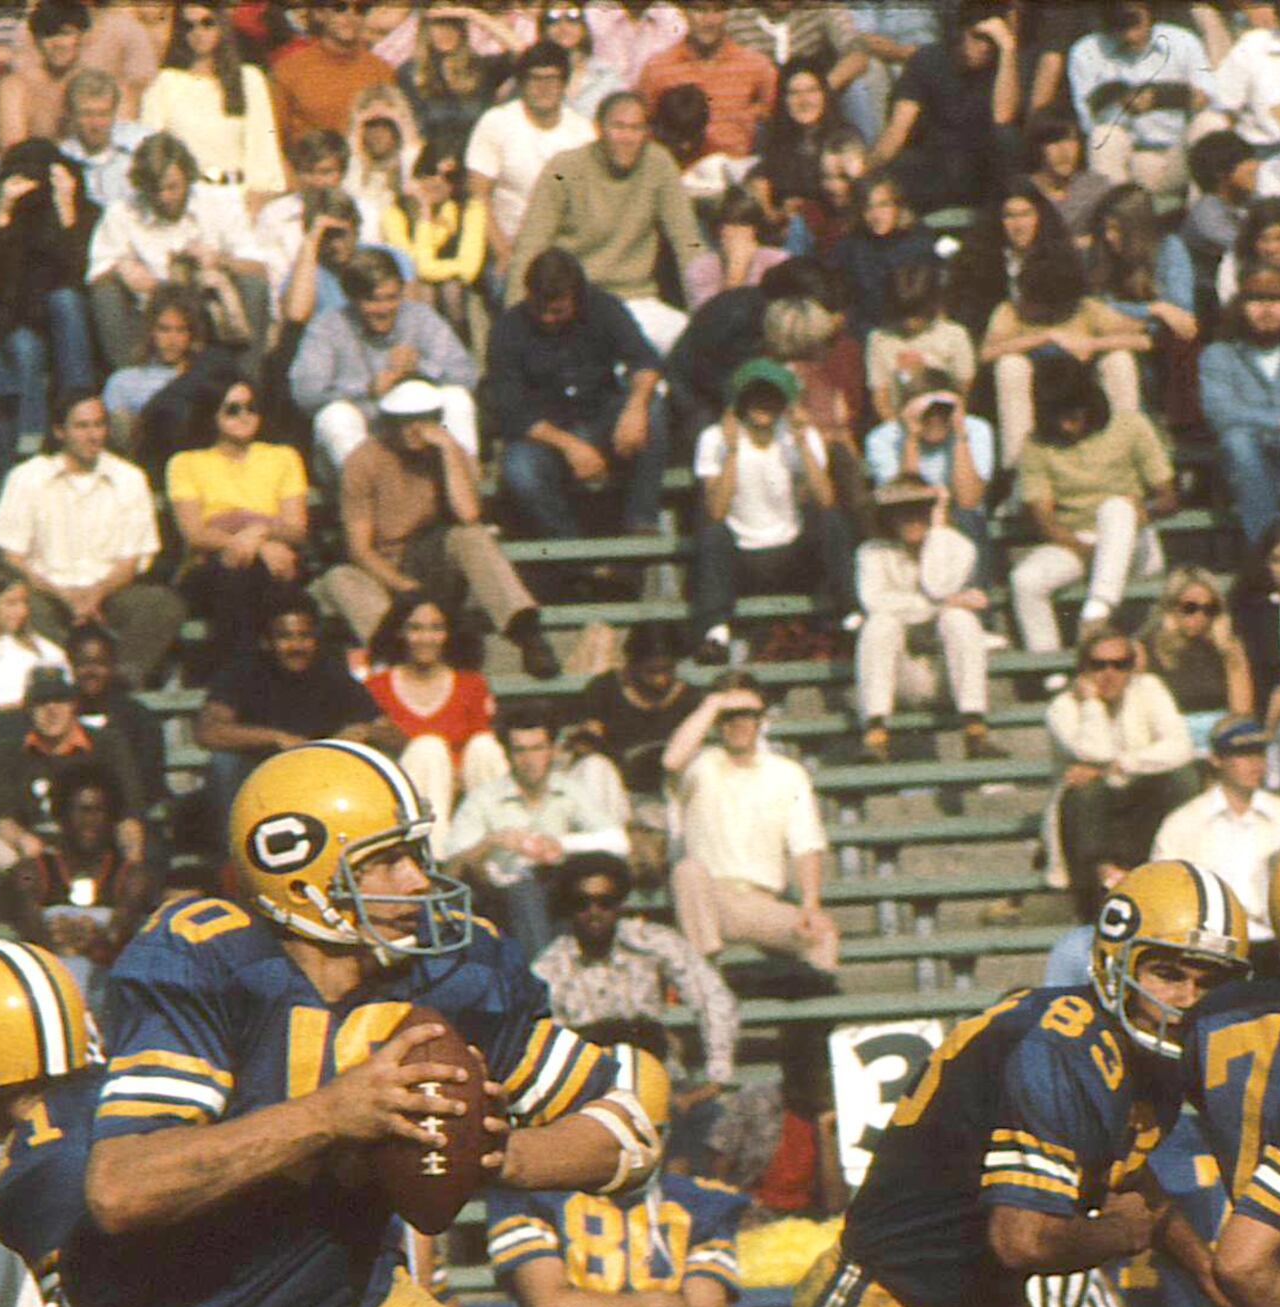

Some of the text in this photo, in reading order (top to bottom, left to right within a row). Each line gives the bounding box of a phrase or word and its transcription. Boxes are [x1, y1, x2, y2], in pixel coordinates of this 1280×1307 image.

[255, 816, 310, 868] C
[1100, 898, 1132, 937] C
[564, 1192, 691, 1294] 80
